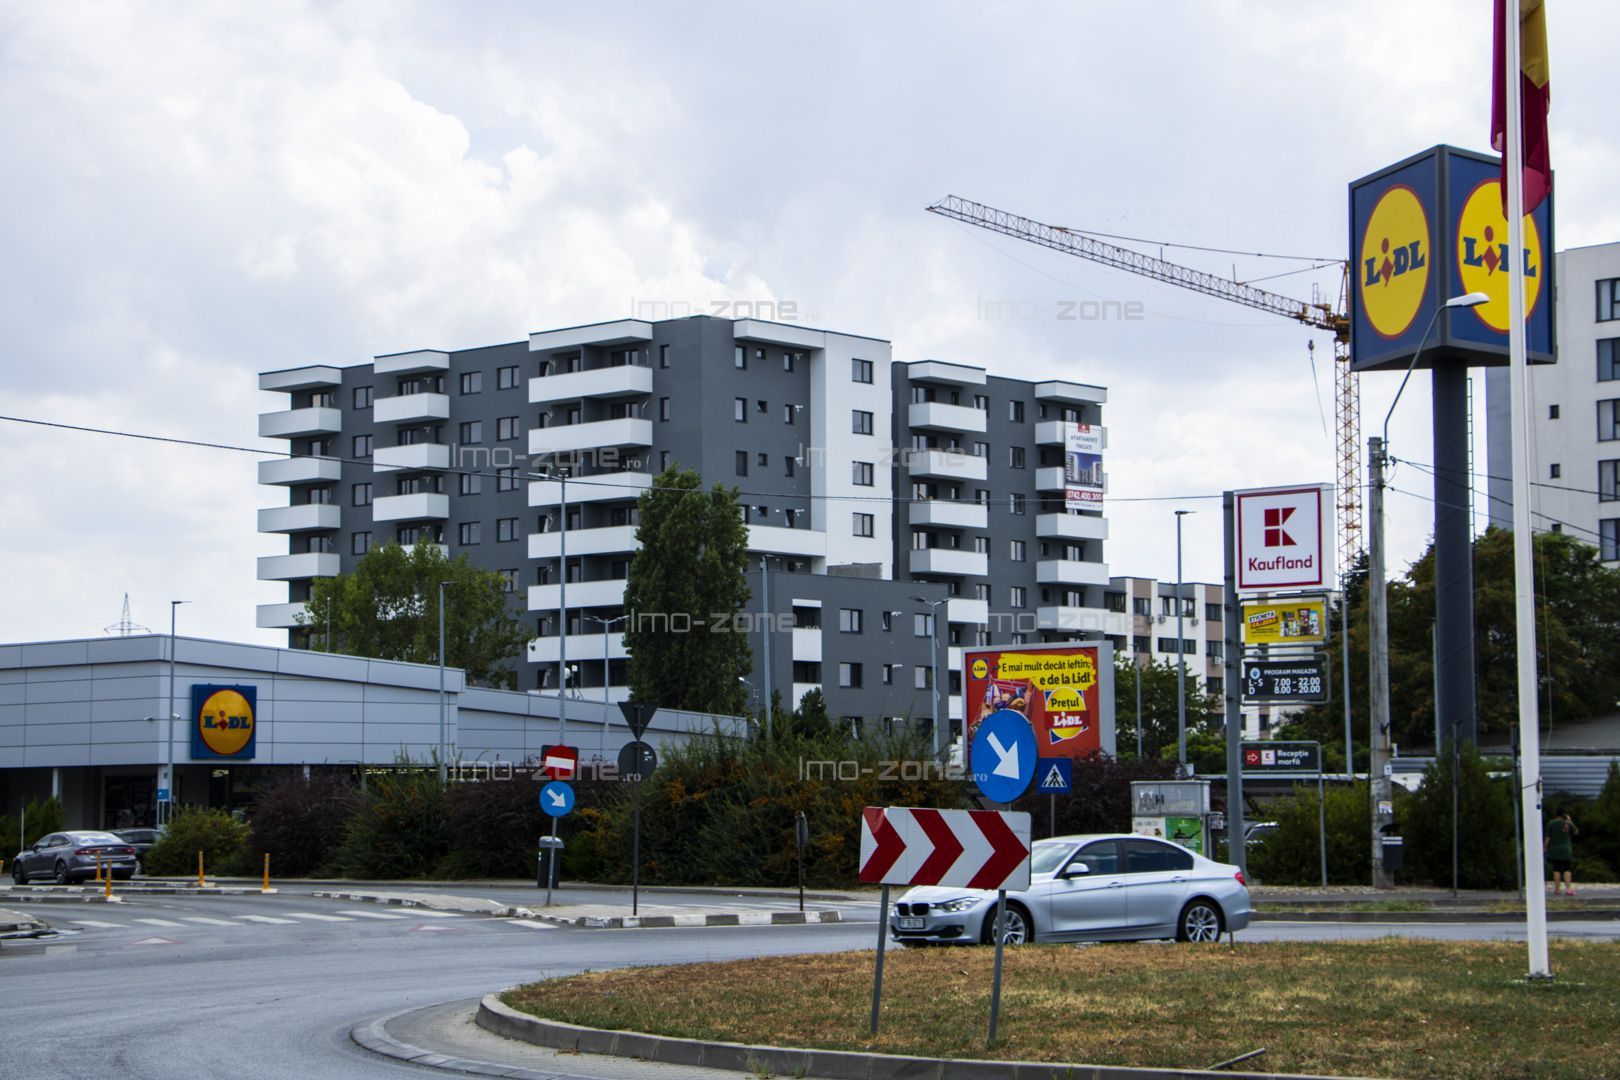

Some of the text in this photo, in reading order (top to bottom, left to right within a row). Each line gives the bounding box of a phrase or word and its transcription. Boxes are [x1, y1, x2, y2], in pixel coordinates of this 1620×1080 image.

[1248, 554, 1312, 571] Kaufland
[1002, 663, 1007, 672] E
[1008, 662, 1022, 672] mai
[1025, 661, 1042, 671] mult
[1039, 672, 1090, 685] e de la Lidl
[1274, 678, 1291, 686] 7.00
[1298, 677, 1320, 686] 22.00
[1248, 687, 1256, 695] D
[1274, 686, 1291, 694] 8.00
[1298, 685, 1320, 694] 20.00
